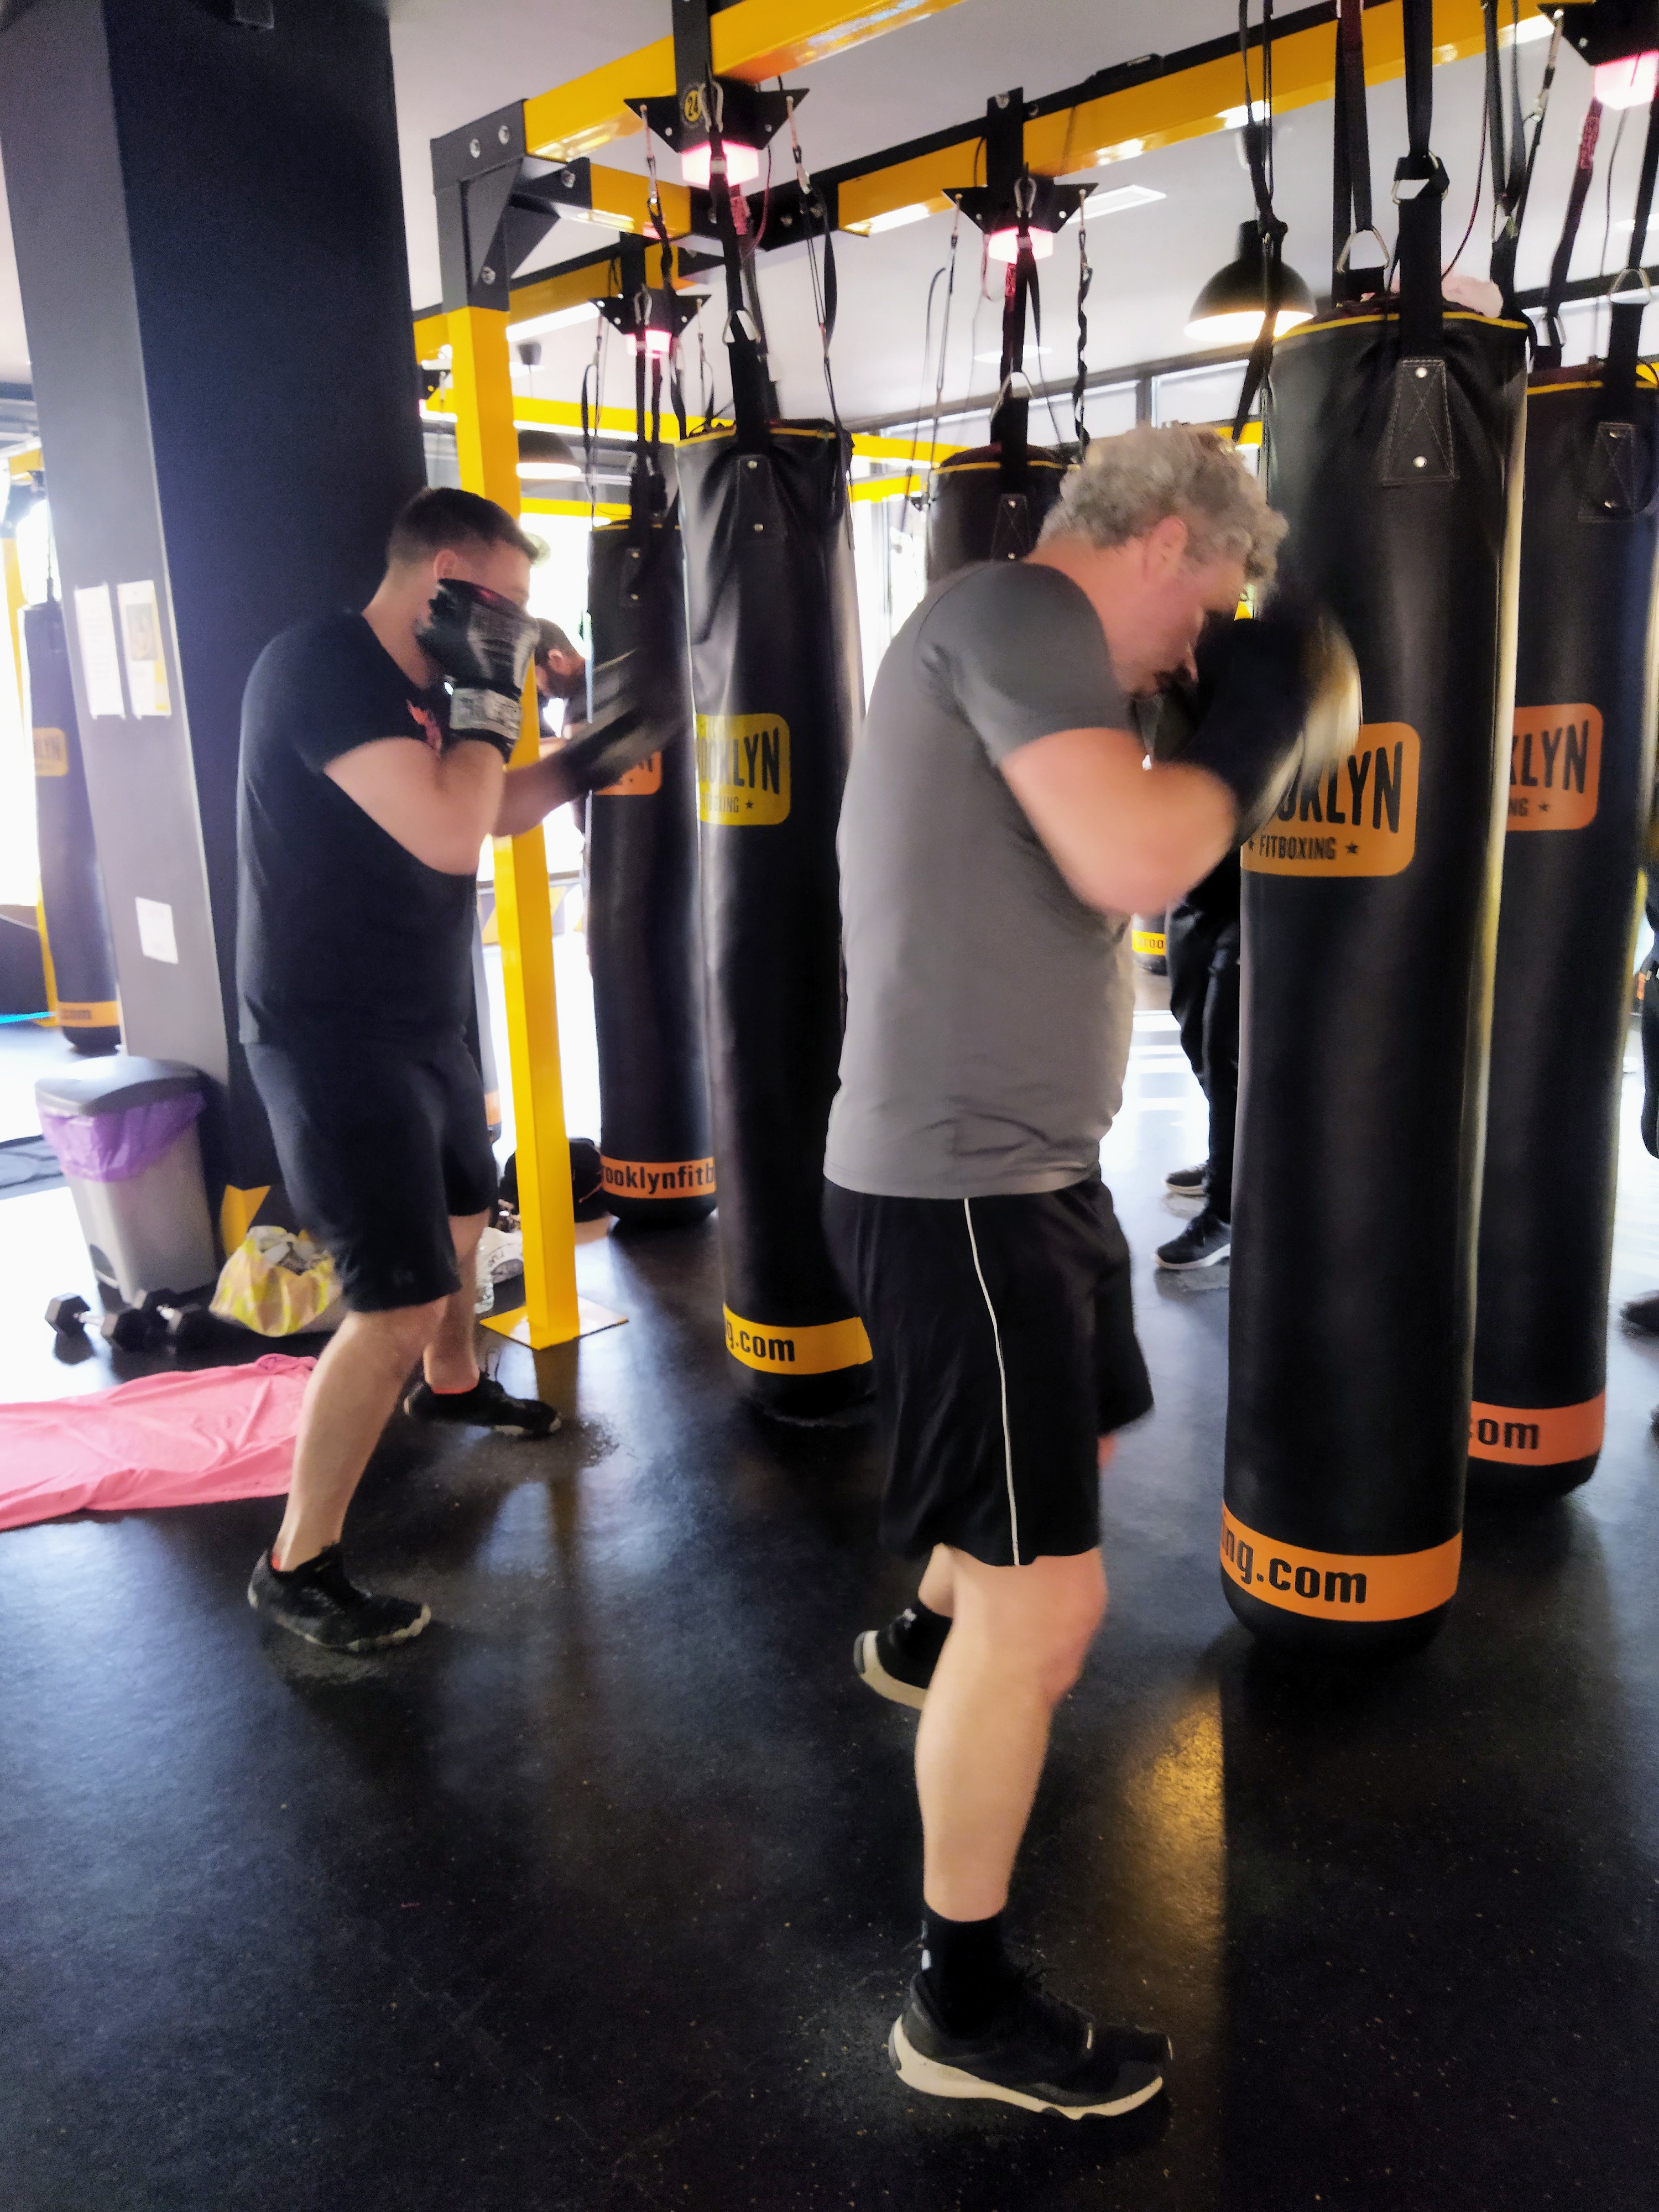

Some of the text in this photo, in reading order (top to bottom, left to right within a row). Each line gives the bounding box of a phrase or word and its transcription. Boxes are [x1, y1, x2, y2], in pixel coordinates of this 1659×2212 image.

[697, 727, 780, 795] OOKLYN
[1259, 833, 1337, 860] FITBOXING
[605, 1163, 714, 1194] ooklynfitb
[1471, 1418, 1540, 1450] om
